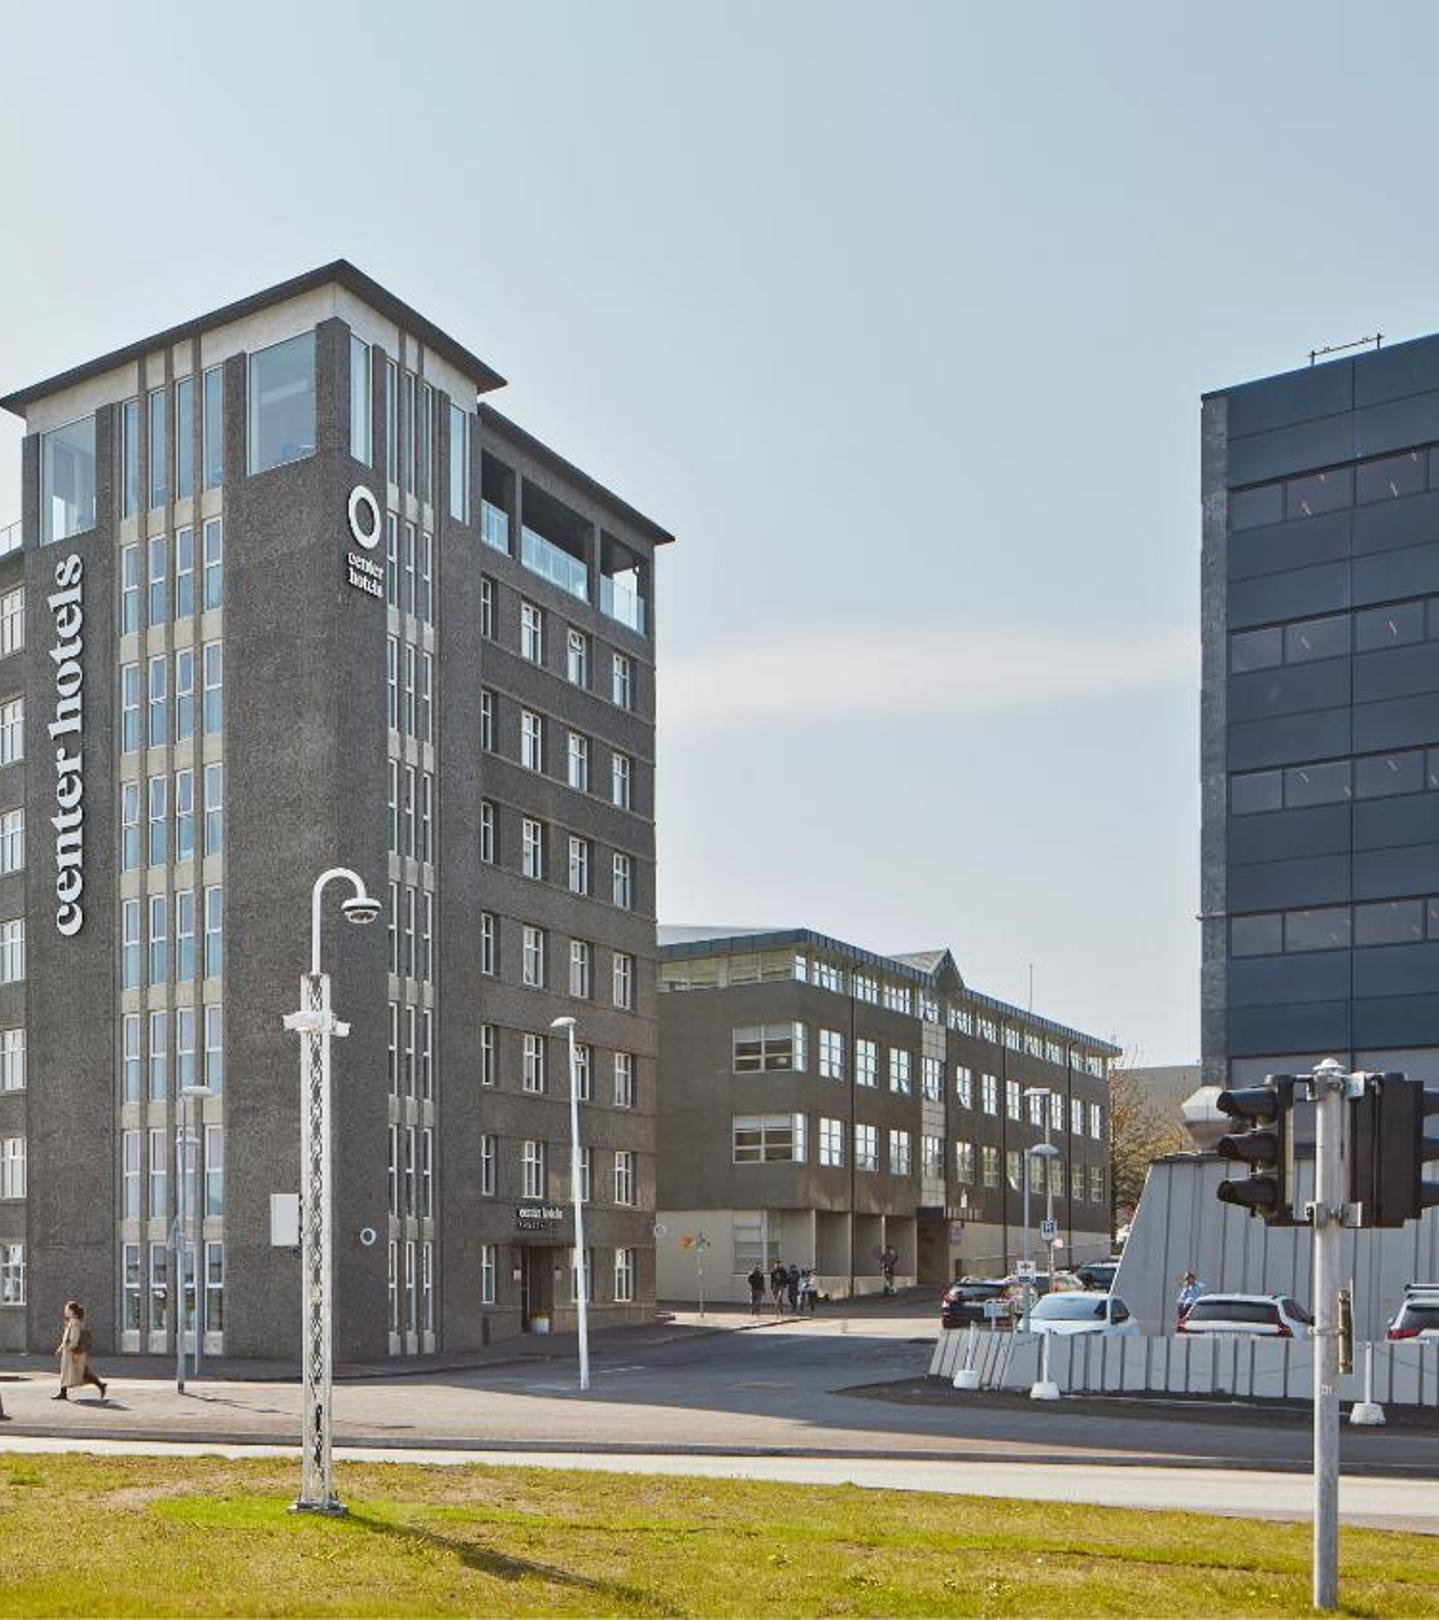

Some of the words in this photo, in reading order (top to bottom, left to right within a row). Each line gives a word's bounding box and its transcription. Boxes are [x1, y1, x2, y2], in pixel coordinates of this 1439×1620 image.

[348, 552, 383, 580] center
[348, 567, 383, 598] hotels
[47, 554, 83, 740] hotels
[51, 747, 83, 936] center
